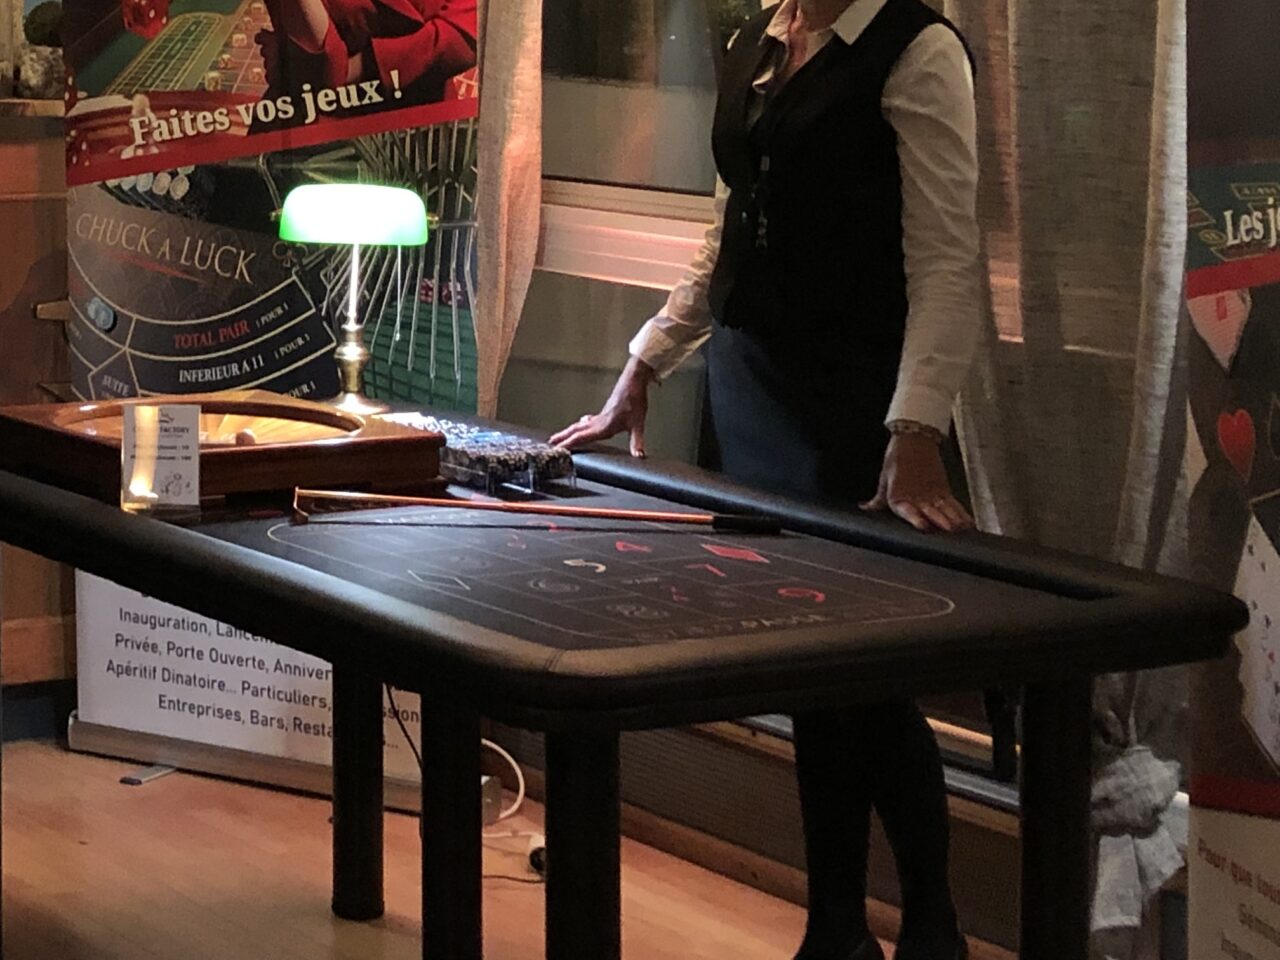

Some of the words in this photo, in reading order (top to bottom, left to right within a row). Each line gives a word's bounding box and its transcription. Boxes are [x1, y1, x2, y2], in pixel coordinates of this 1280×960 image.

[129, 105, 231, 146] Faites
[236, 95, 295, 126] vos
[301, 79, 384, 123] jeux
[1223, 209, 1265, 247] Les
[1267, 196, 1280, 248] j
[76, 212, 156, 255] CHUCK
[157, 238, 170, 261] A
[180, 236, 257, 285] LUCK
[174, 330, 214, 349] TOTAL
[220, 320, 251, 343] PAIR
[261, 305, 283, 326] POUR
[179, 362, 240, 383] INFERIEUR
[252, 353, 265, 370] 11
[280, 336, 305, 357] POUR
[287, 383, 310, 398] OUR
[119, 607, 212, 637] Inauguration,
[115, 633, 162, 656] Privée,
[167, 640, 204, 661] Porte
[209, 648, 269, 674] Ouverte,
[106, 659, 157, 680] Apéritif
[161, 667, 236, 694] Dinatoire...
[241, 680, 332, 712] Particuliers,
[158, 693, 246, 725] Entreprises,
[250, 709, 288, 732] Bars,
